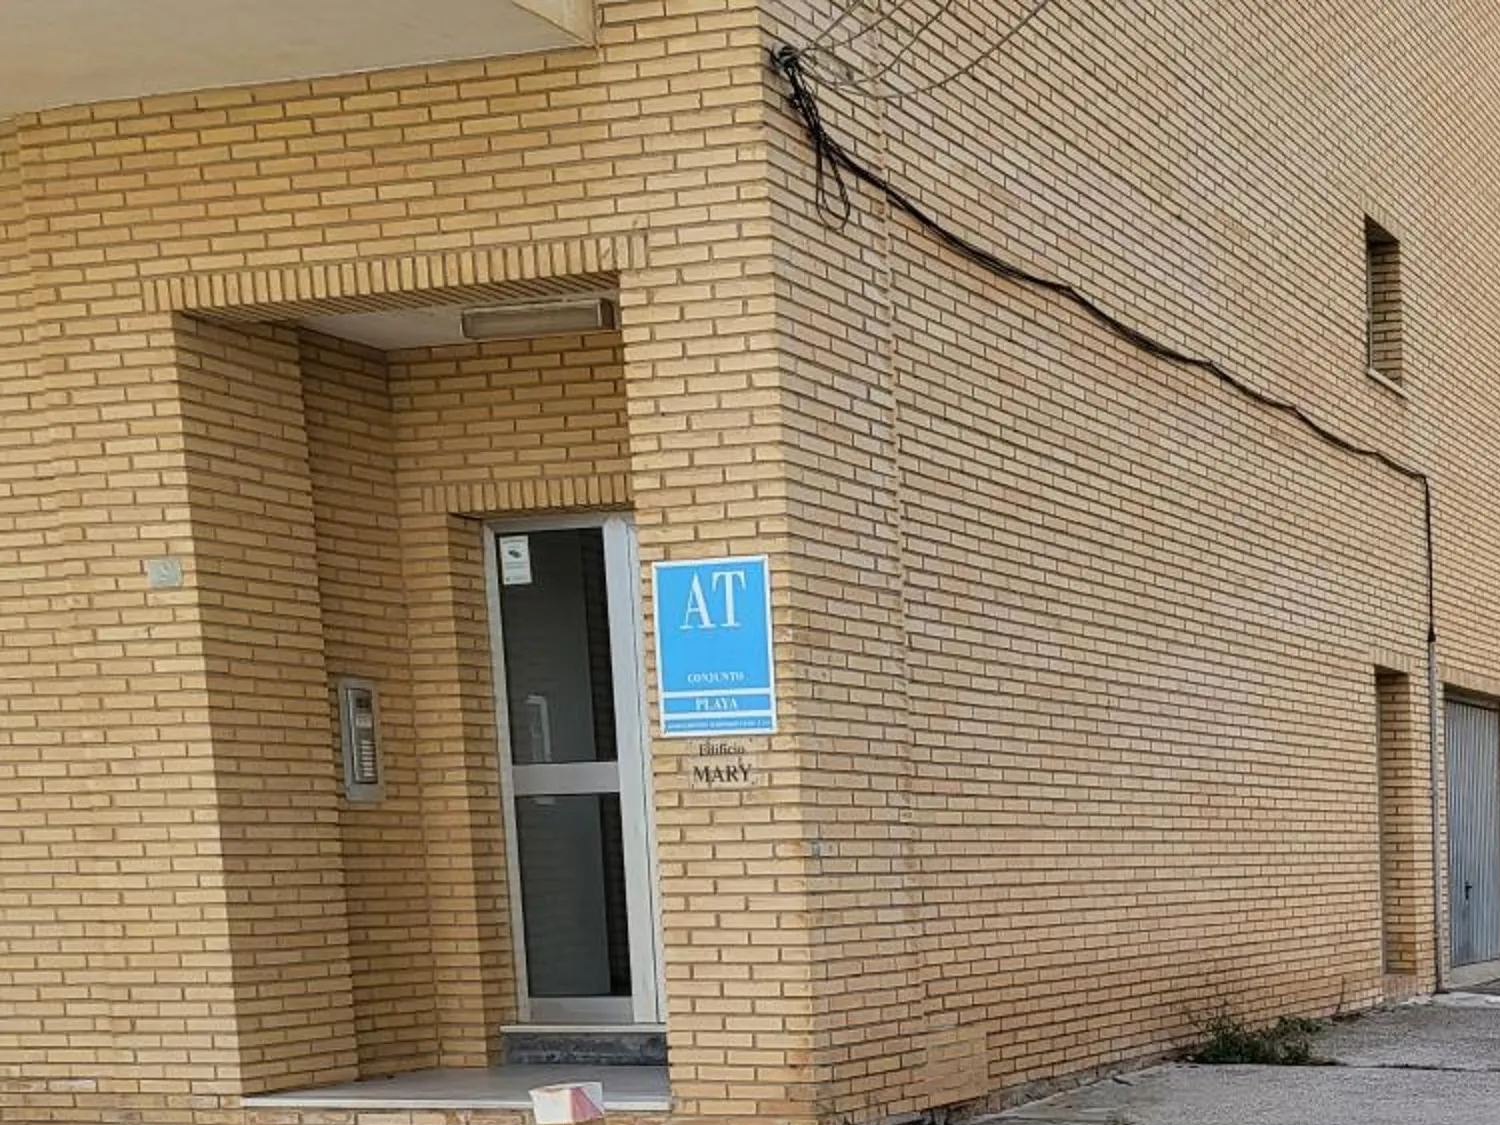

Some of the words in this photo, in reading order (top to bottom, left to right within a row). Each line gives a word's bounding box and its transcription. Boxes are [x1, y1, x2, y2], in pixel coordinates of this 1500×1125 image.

[680, 570, 747, 629] AT
[687, 671, 745, 683] CONJUNTO
[695, 697, 738, 711] PLAYA
[693, 764, 752, 783] MARY
